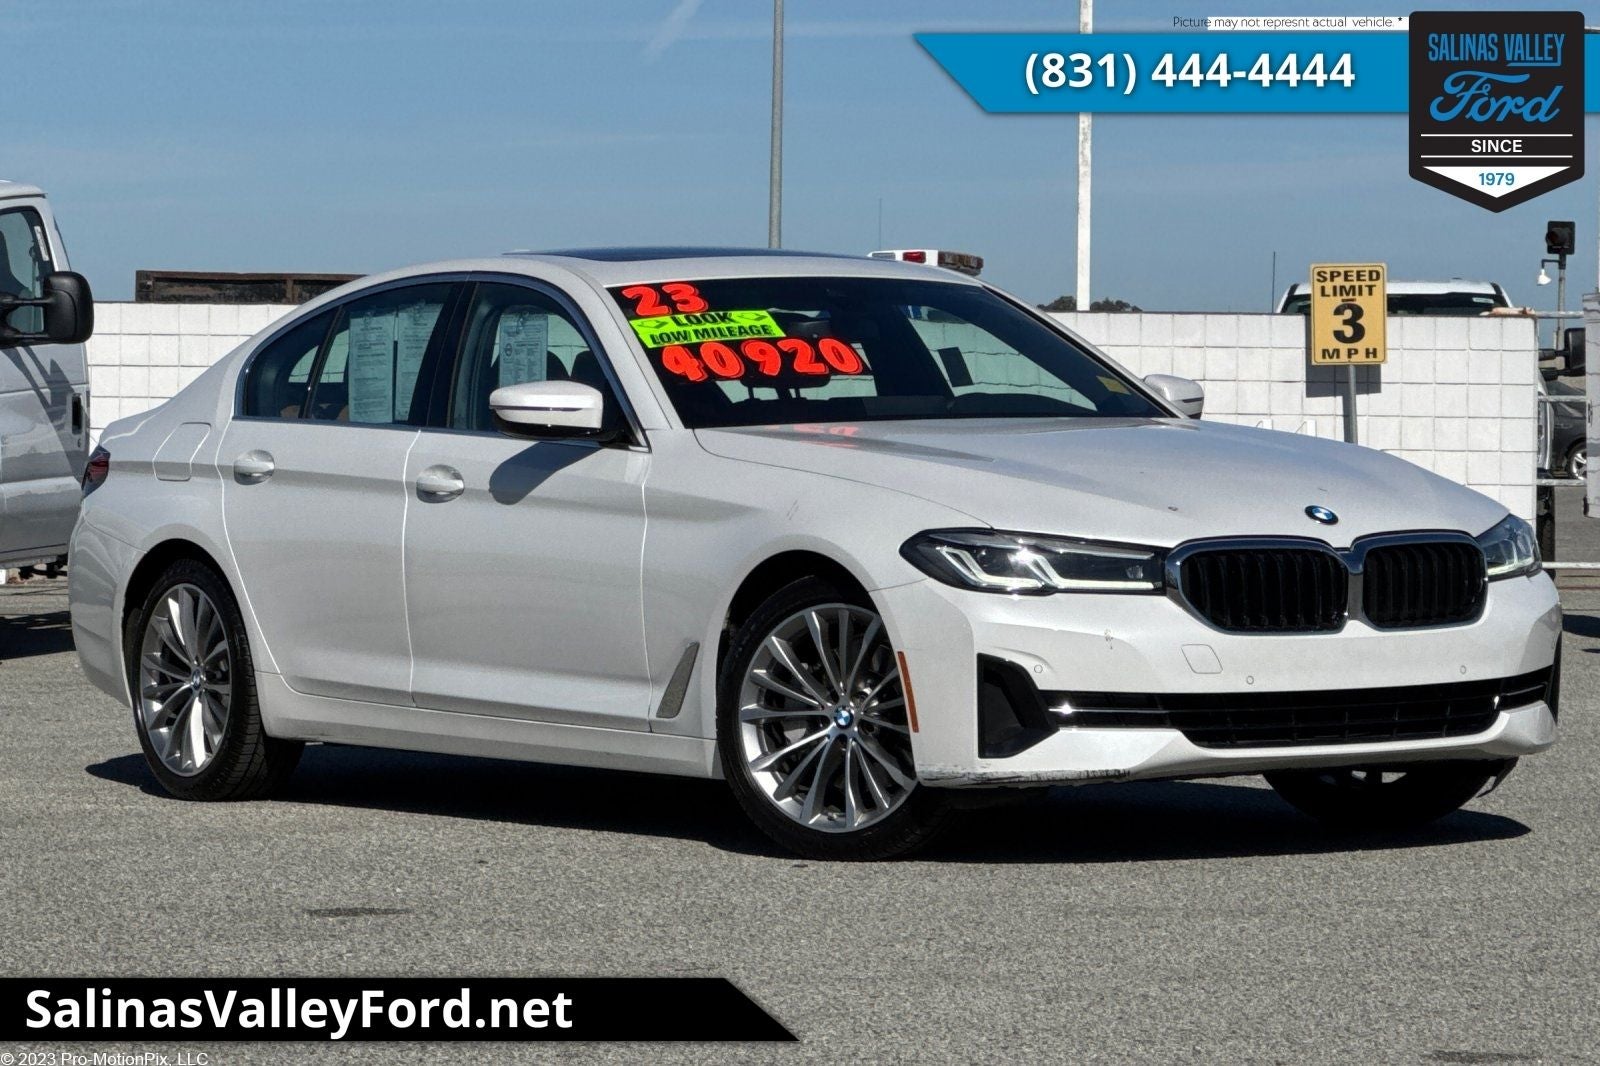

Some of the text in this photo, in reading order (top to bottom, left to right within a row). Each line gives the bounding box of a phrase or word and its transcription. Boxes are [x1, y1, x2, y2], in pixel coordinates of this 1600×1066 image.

[1316, 269, 1381, 283] SPEED
[621, 281, 709, 317] 23
[1320, 285, 1376, 297] LIMIT
[671, 312, 734, 327] LOOK
[1332, 302, 1366, 344] 3
[650, 324, 773, 345] LOW MILEAGE
[661, 338, 863, 382] 40920
